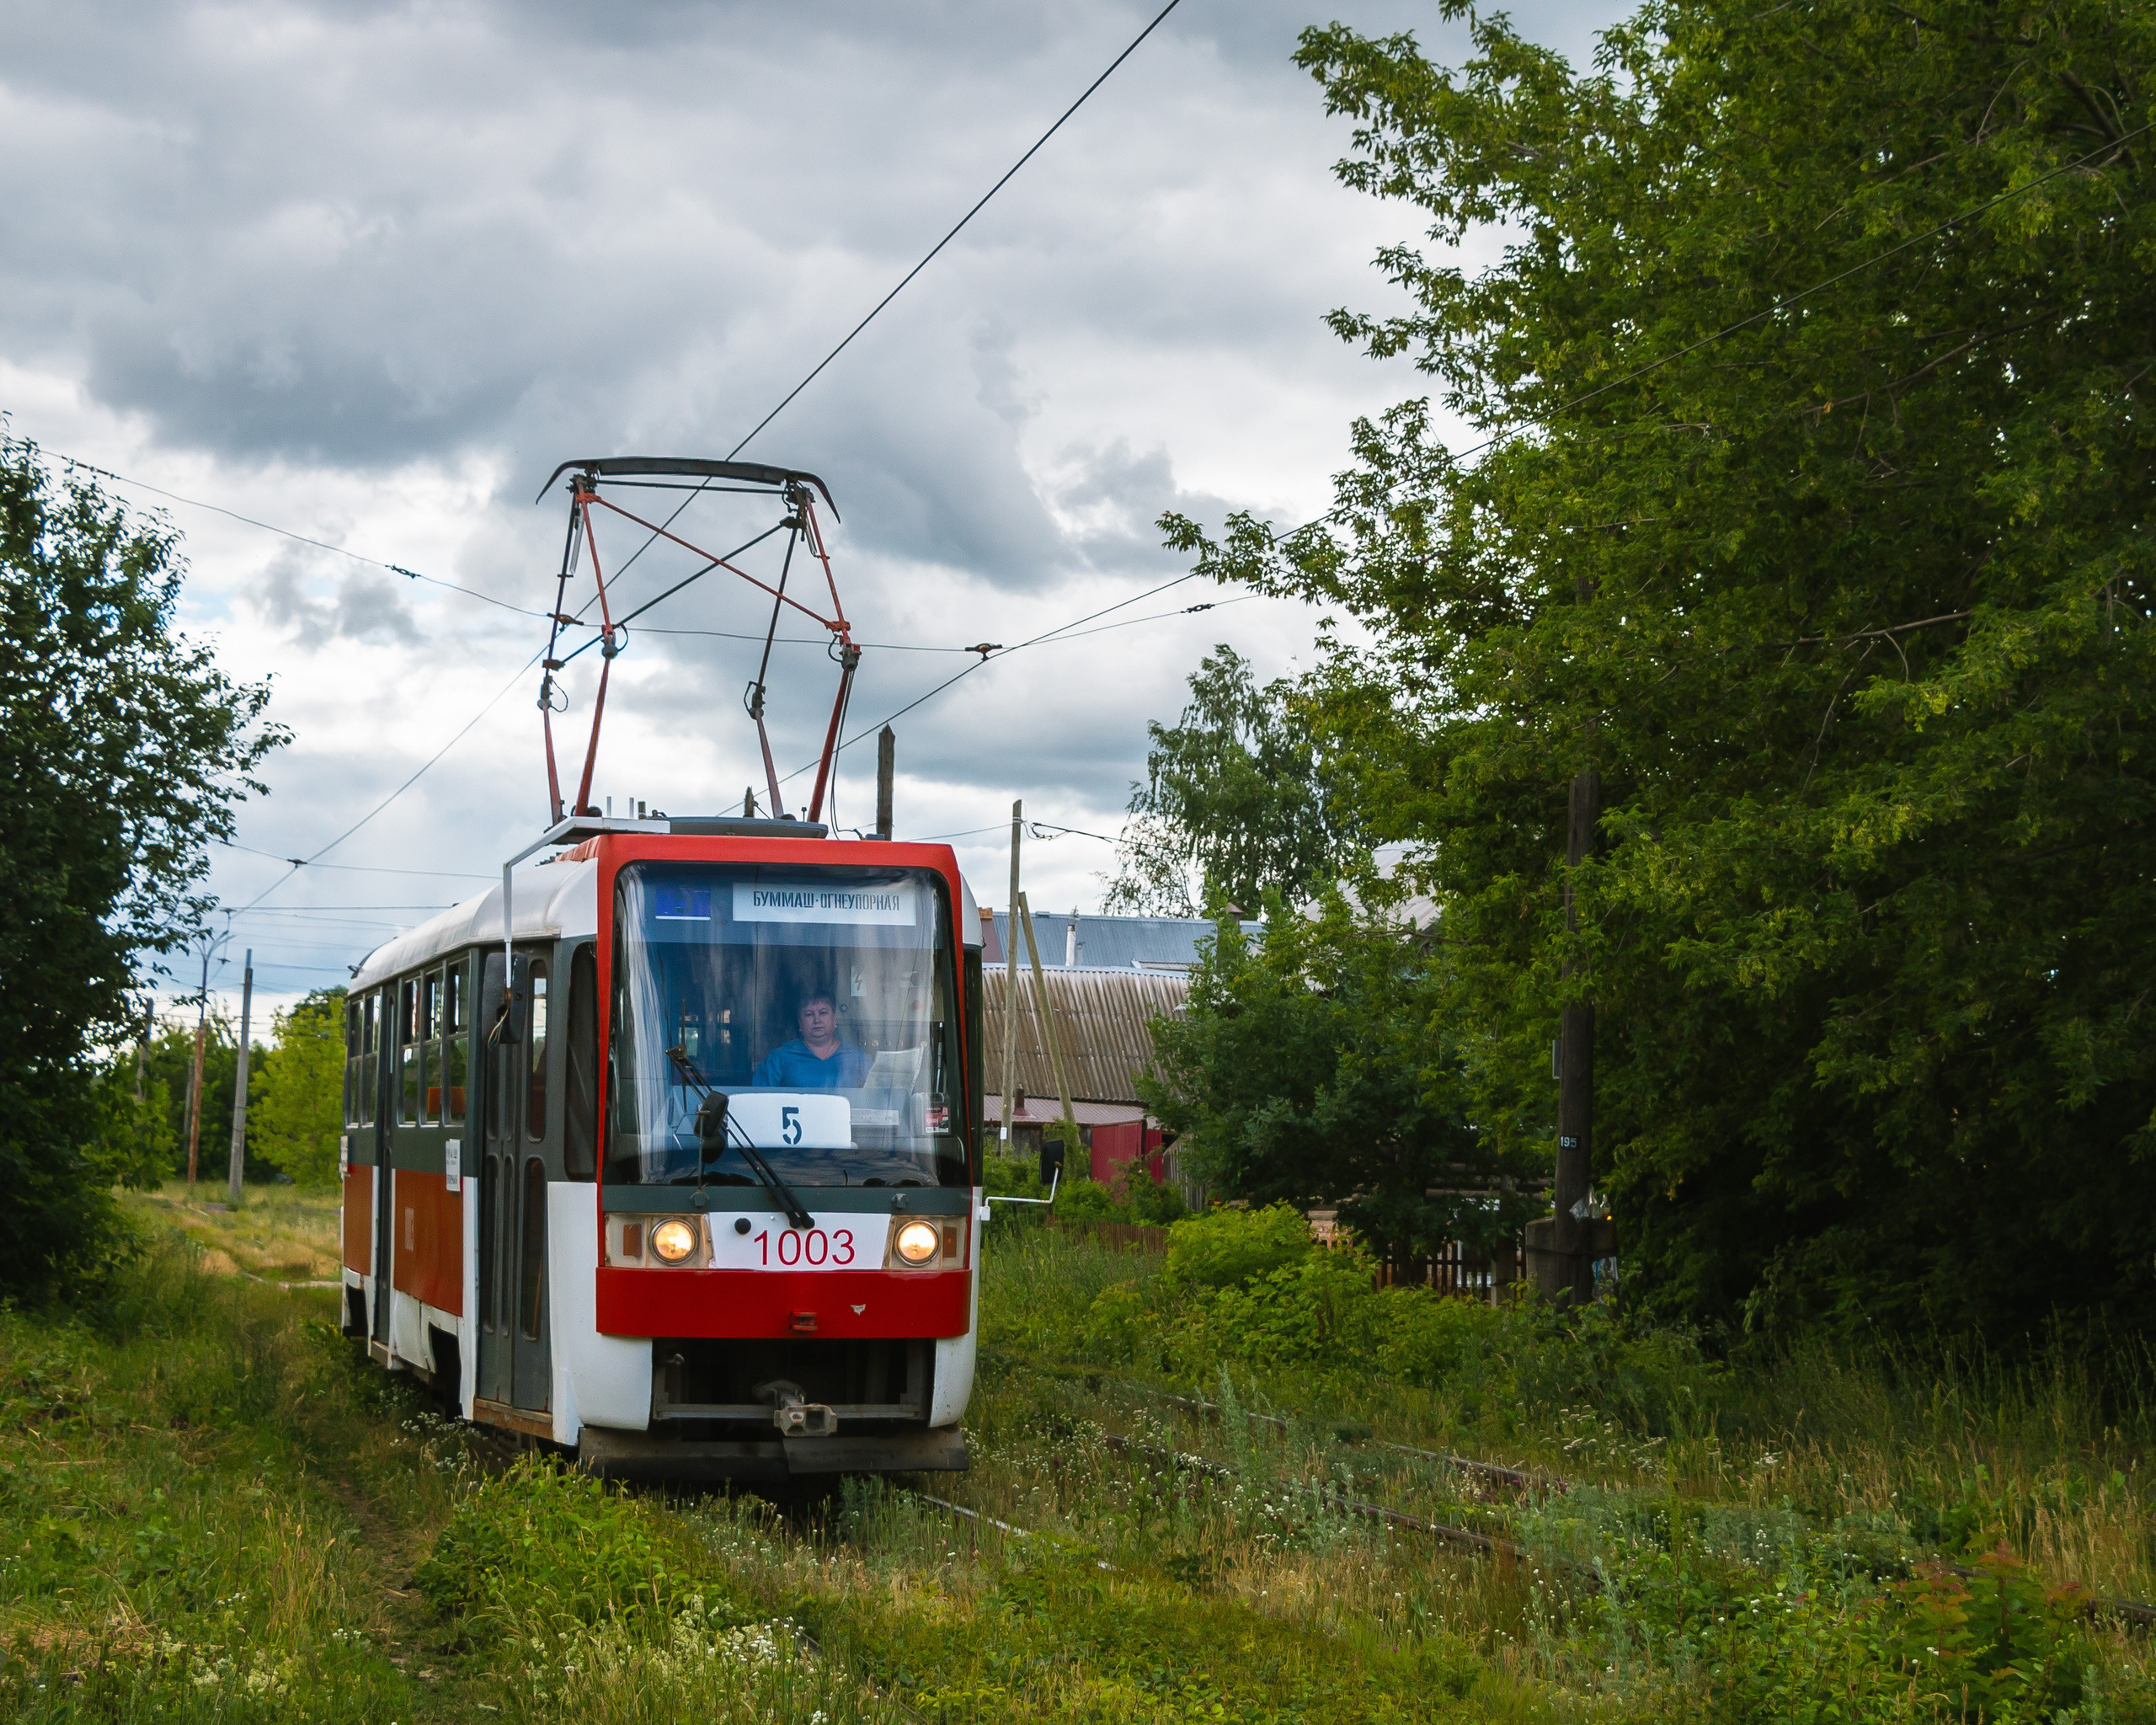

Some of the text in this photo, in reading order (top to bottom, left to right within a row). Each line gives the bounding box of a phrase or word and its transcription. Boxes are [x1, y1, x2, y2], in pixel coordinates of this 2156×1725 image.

[782, 1106, 803, 1146] 5
[1560, 1135, 1577, 1148] 195
[754, 1229, 856, 1266] 1003
